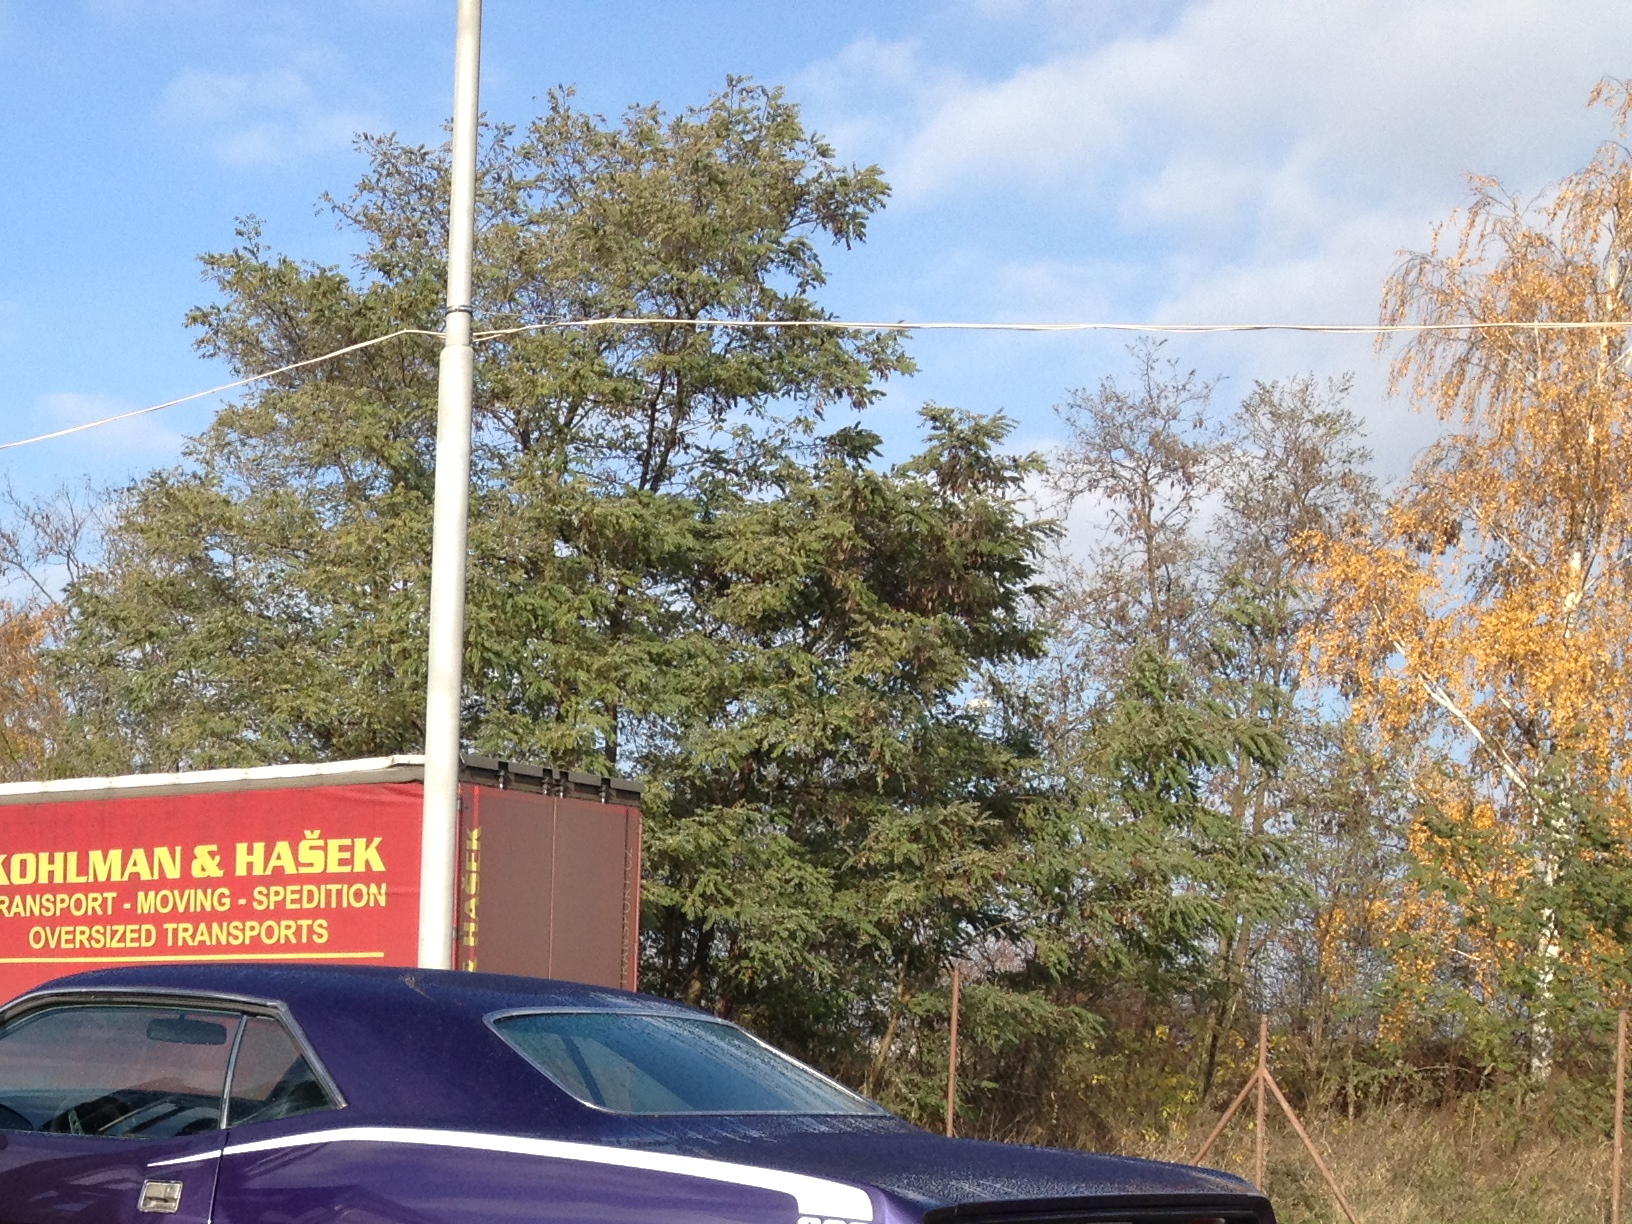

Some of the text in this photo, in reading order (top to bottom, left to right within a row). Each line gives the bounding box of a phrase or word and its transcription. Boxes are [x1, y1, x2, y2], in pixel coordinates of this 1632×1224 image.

[191, 844, 224, 878] &
[235, 829, 386, 877] HAŠEK
[137, 887, 231, 914] MOVING
[252, 883, 386, 911] SPEDITION
[28, 919, 328, 949] OVERSIZED TRANSPORTS
